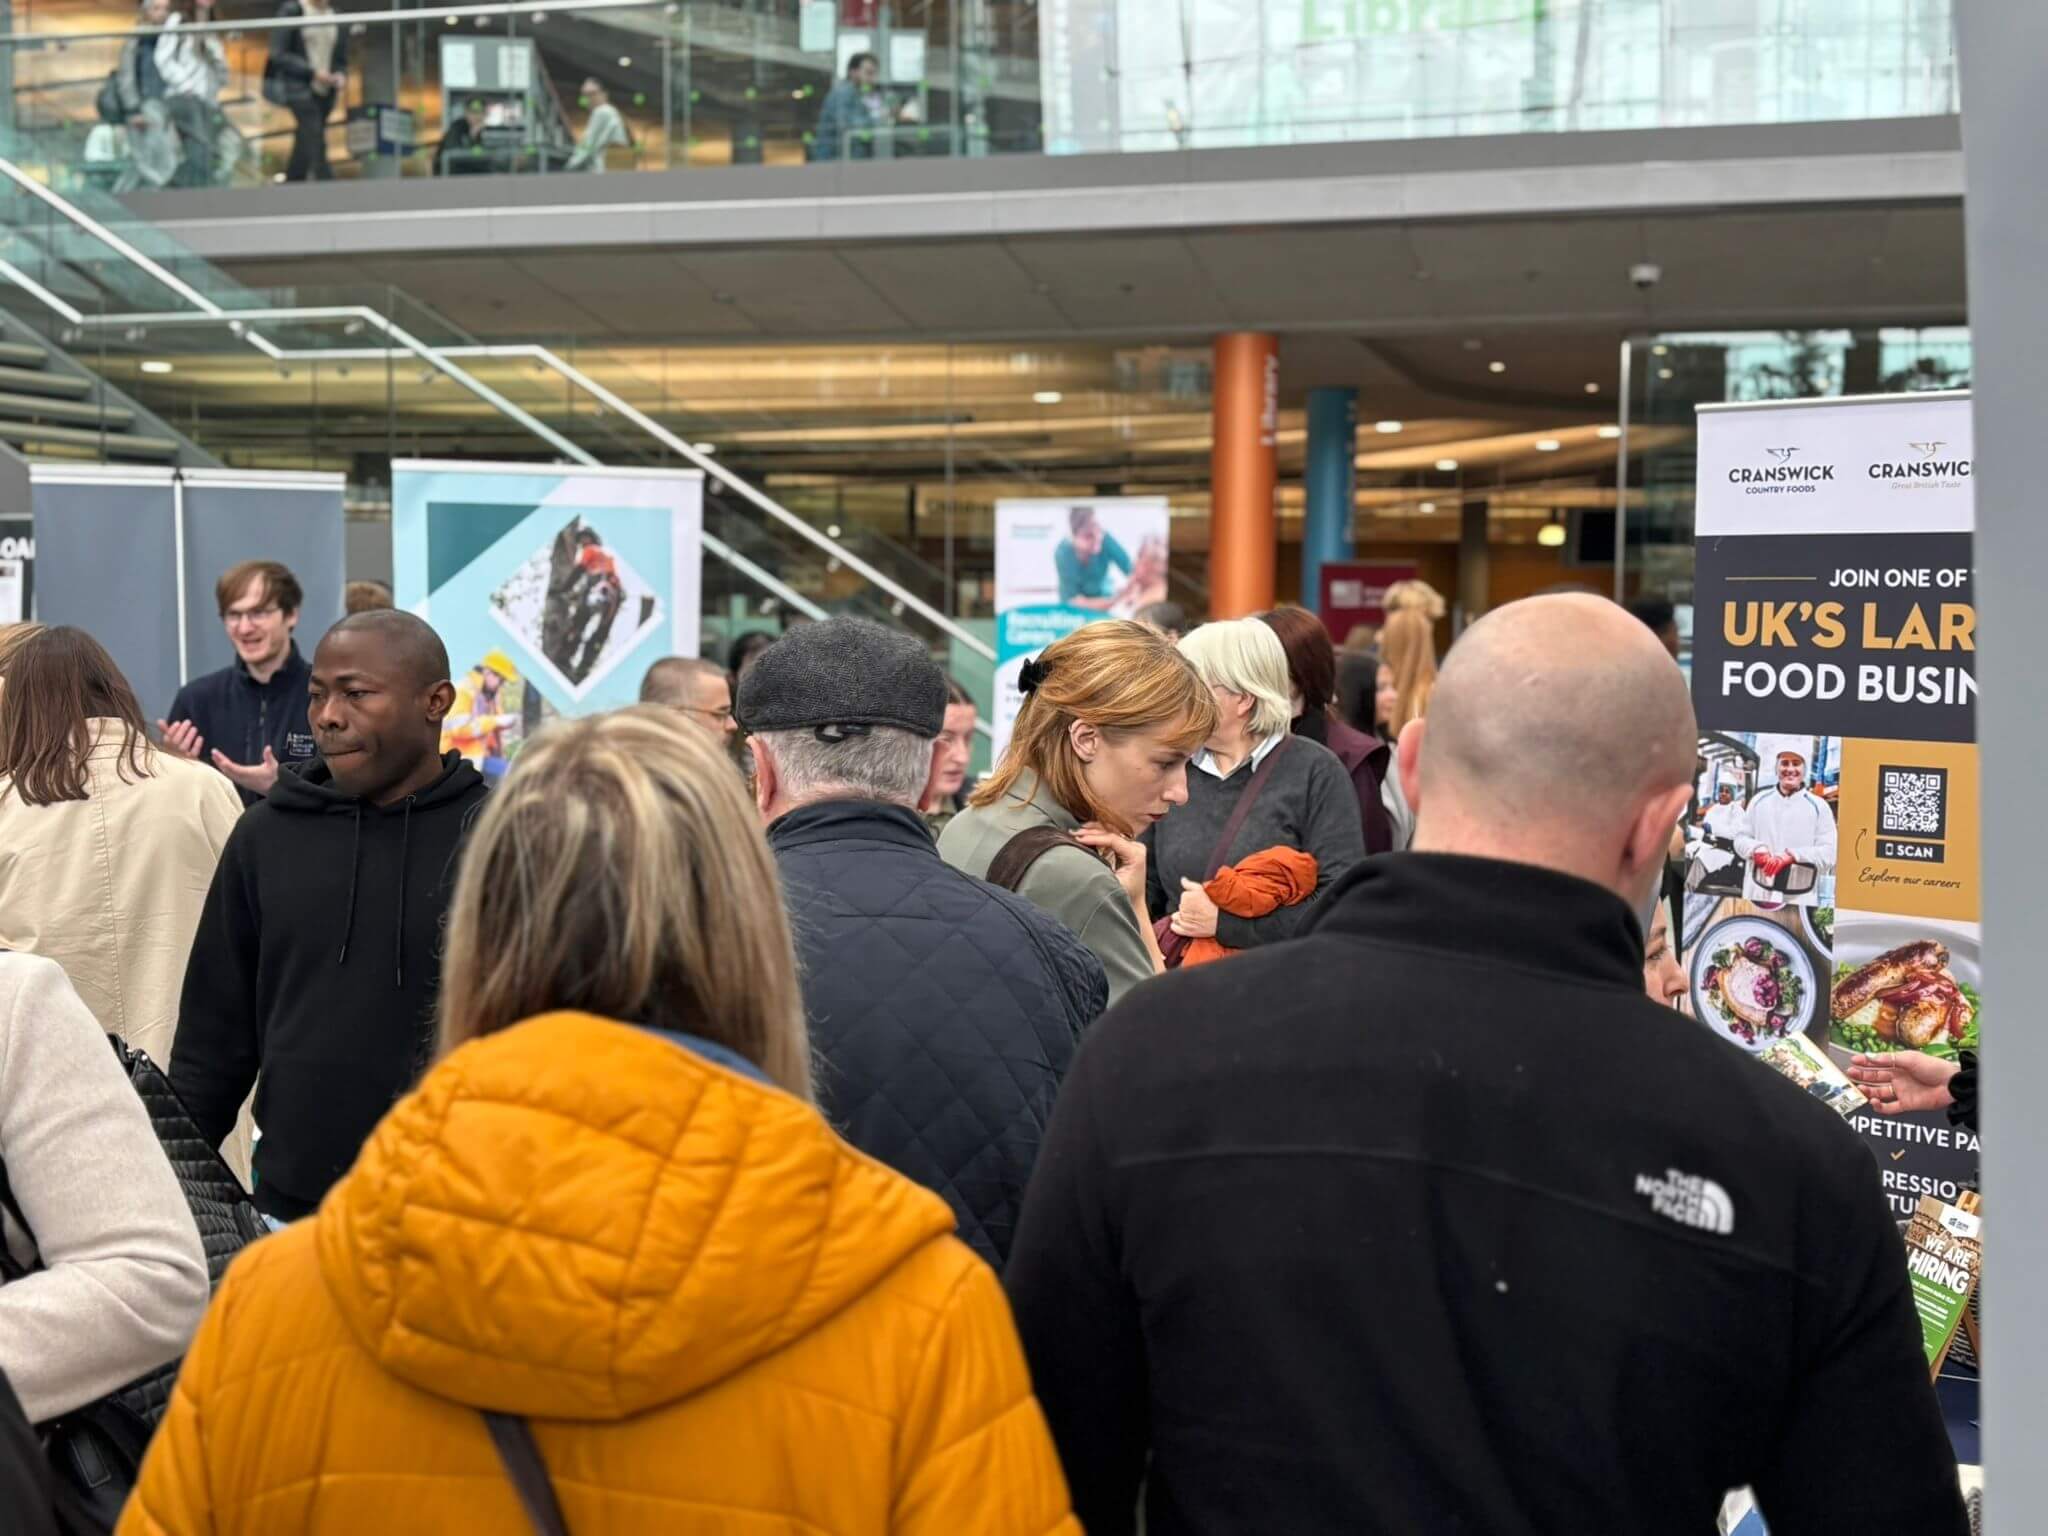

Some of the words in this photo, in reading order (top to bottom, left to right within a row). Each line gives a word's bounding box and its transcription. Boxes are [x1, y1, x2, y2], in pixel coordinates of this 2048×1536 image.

[1728, 464, 1835, 483] CRANSWICK
[1868, 460, 1975, 479] CRANSWIC
[1745, 486, 1785, 495] COUNTRY
[1786, 484, 1816, 493] FOODS
[1892, 481, 1912, 490] Great
[1914, 480, 1939, 489] British
[1941, 479, 1961, 488] Taste
[1829, 568, 1880, 588] JOIN
[1884, 567, 1931, 588] ONE
[1936, 567, 1968, 588] OF
[1723, 600, 1847, 649] UK’S
[1862, 602, 1976, 651] LAR
[1721, 660, 1846, 700] FOOD
[1897, 845, 1934, 858] SCAN
[1858, 866, 1901, 888] Explore
[1903, 877, 1921, 885] our
[1923, 879, 1961, 889] careers
[1634, 1173, 1702, 1210] NORTH
[1665, 1167, 1703, 1194] THE
[1882, 1169, 1957, 1199] RESSIO
[1652, 1193, 1700, 1226] FACE
[1886, 1193, 1920, 1215] TU
[1925, 1234, 1946, 1256] WE
[1942, 1246, 1971, 1269] ARE
[1907, 1246, 1970, 1294] HIRING
